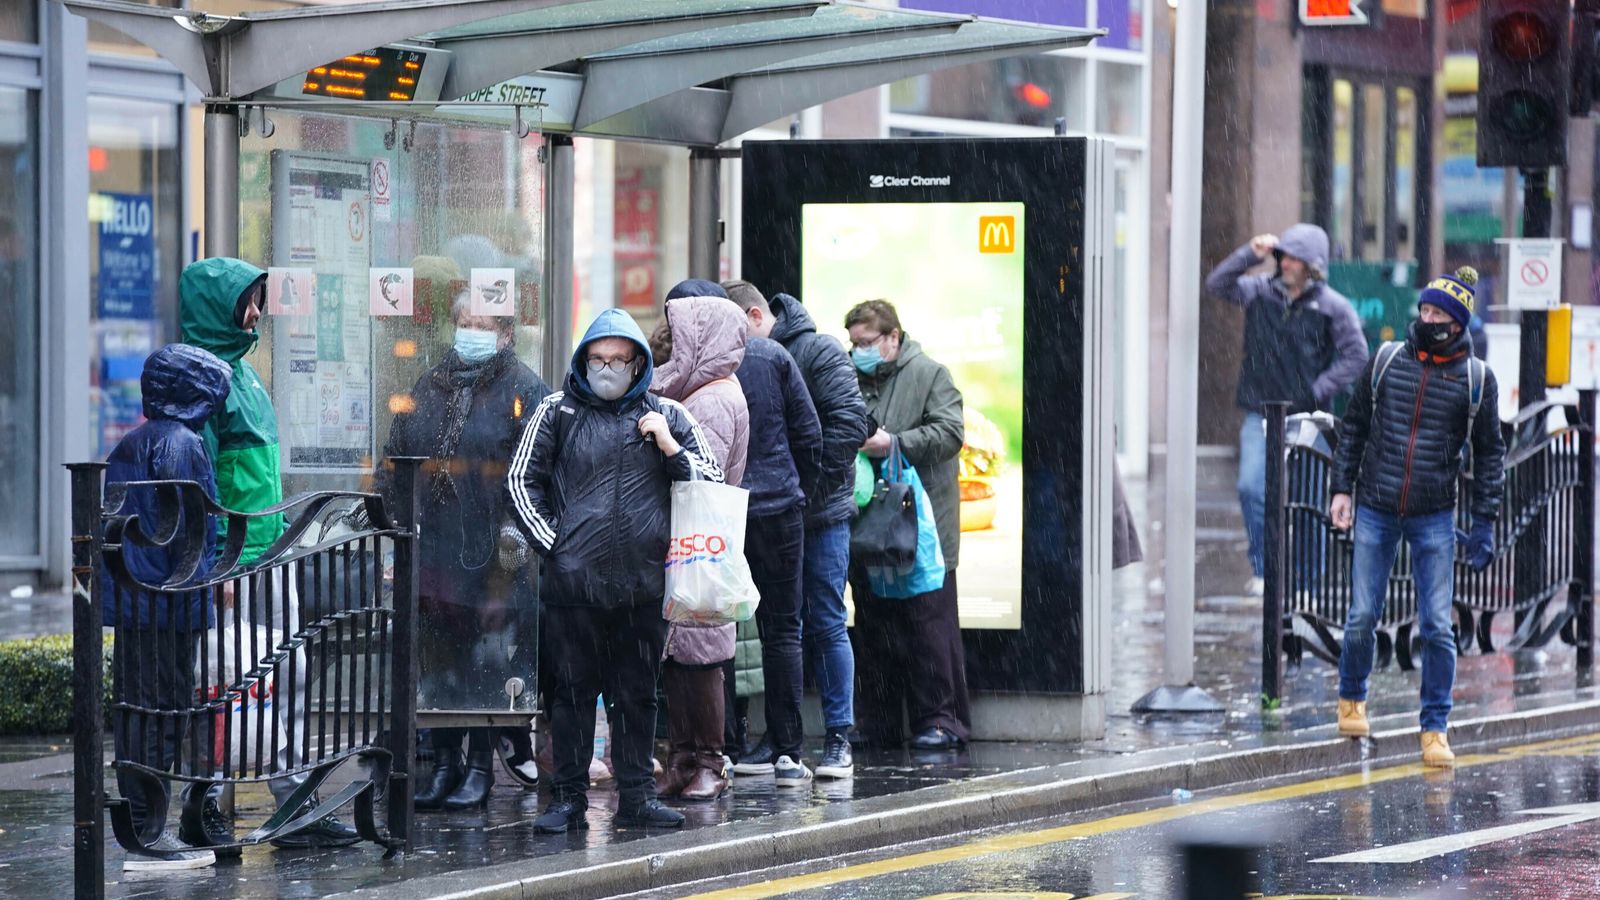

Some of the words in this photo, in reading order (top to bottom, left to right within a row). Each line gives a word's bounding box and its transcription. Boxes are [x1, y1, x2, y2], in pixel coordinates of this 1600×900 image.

[498, 84, 546, 107] STREET
[884, 176, 910, 186] Clear
[911, 175, 951, 186] Channel
[667, 533, 726, 558] ESCO
